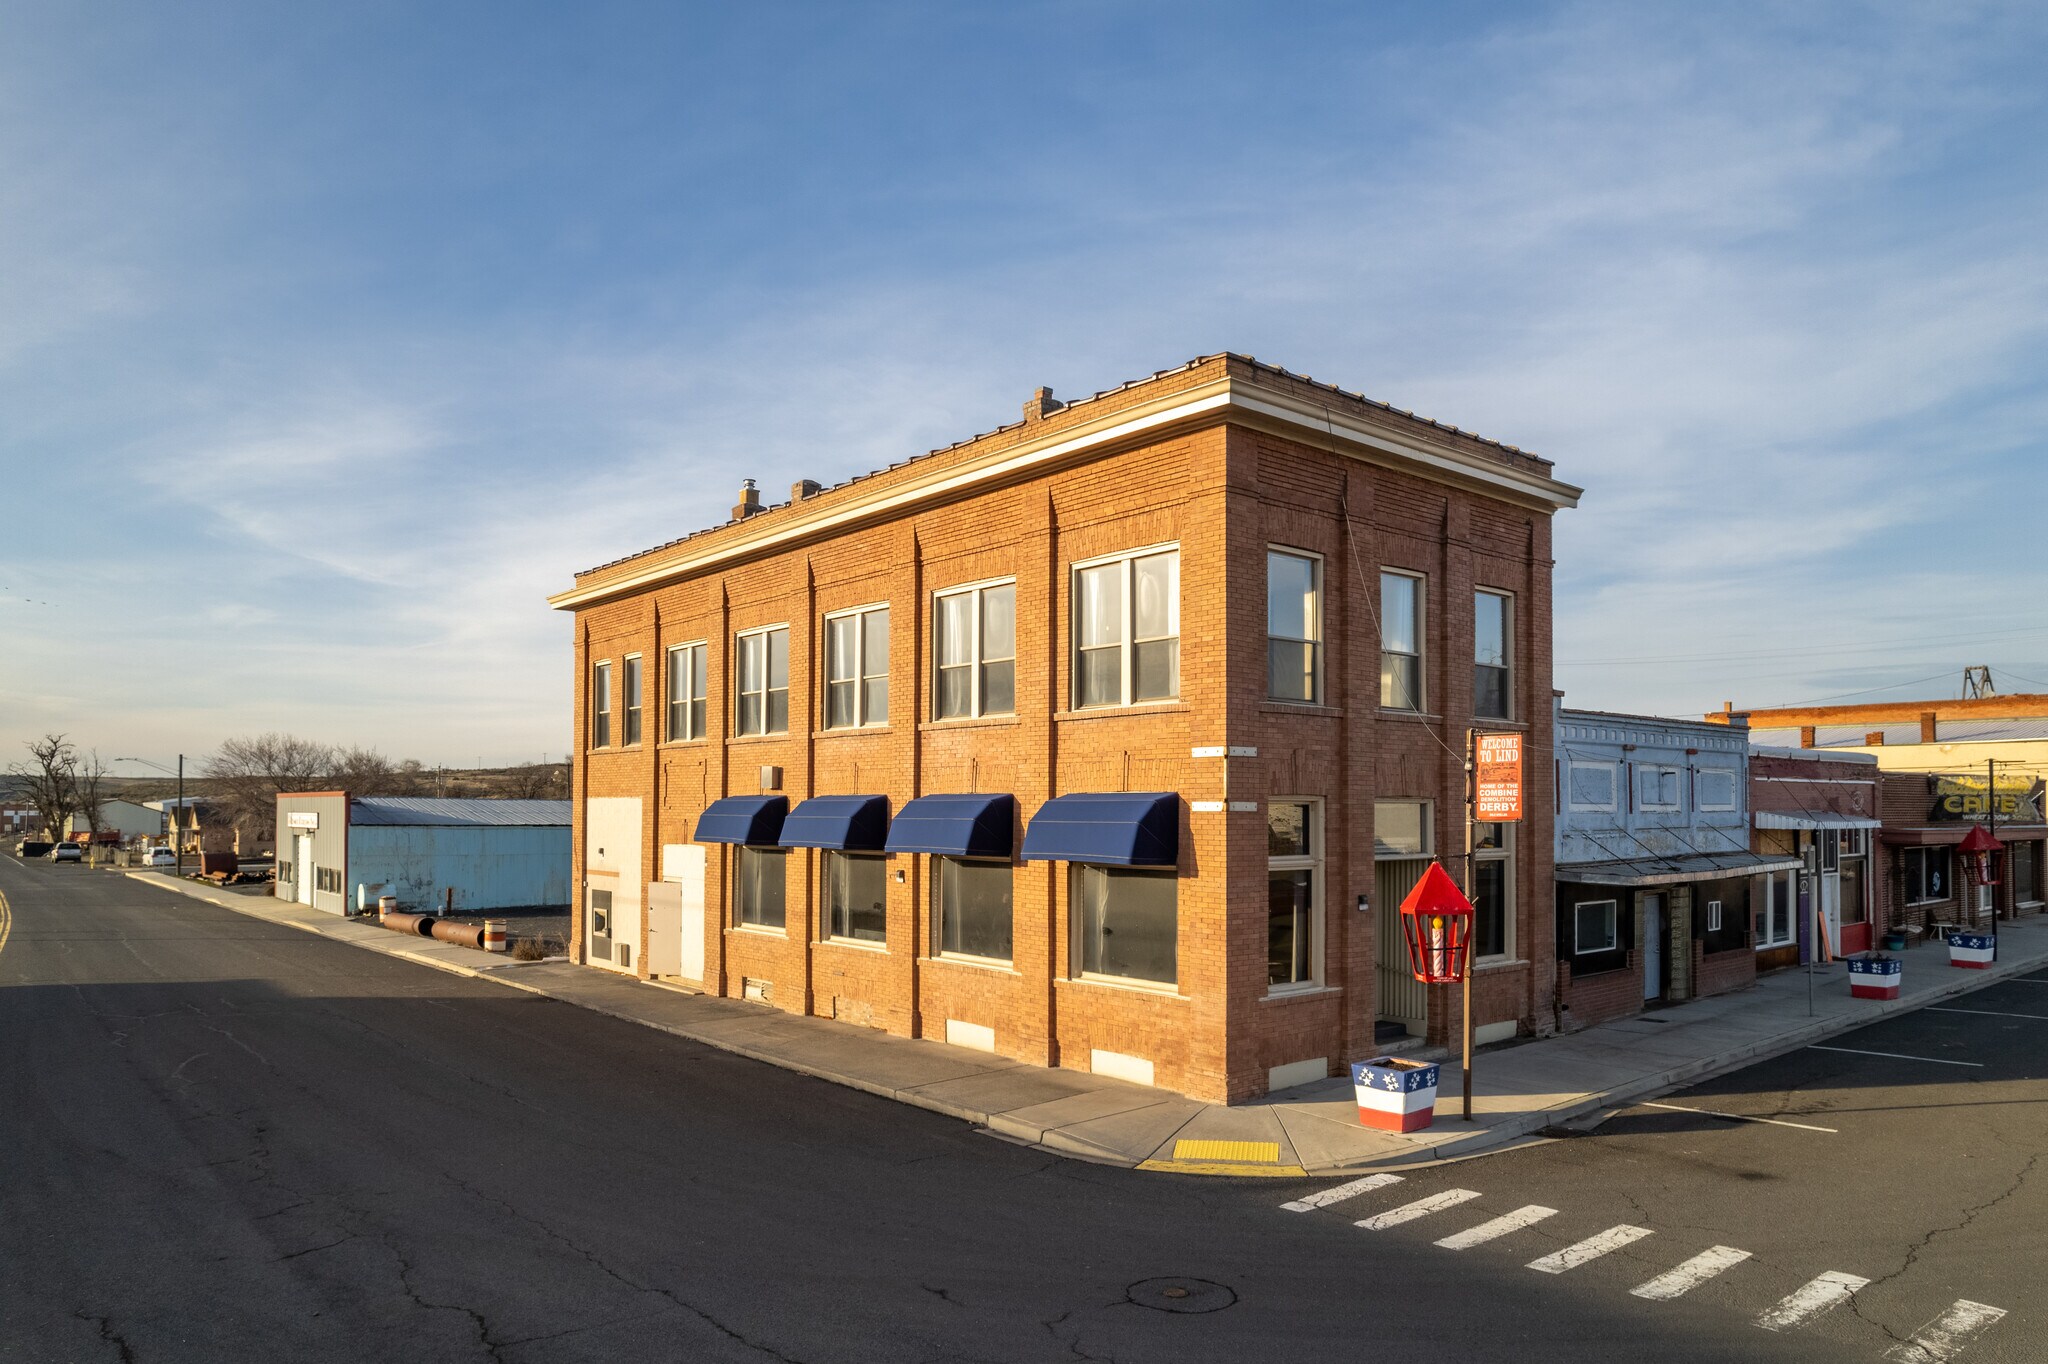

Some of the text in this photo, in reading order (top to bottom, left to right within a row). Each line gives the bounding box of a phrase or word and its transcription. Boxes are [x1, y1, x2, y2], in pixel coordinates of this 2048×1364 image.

[1481, 738, 1518, 749] WELCOME
[1480, 749, 1518, 762] TO LIND
[1479, 789, 1518, 797] COMBINE
[1944, 796, 2016, 813] CAFE
